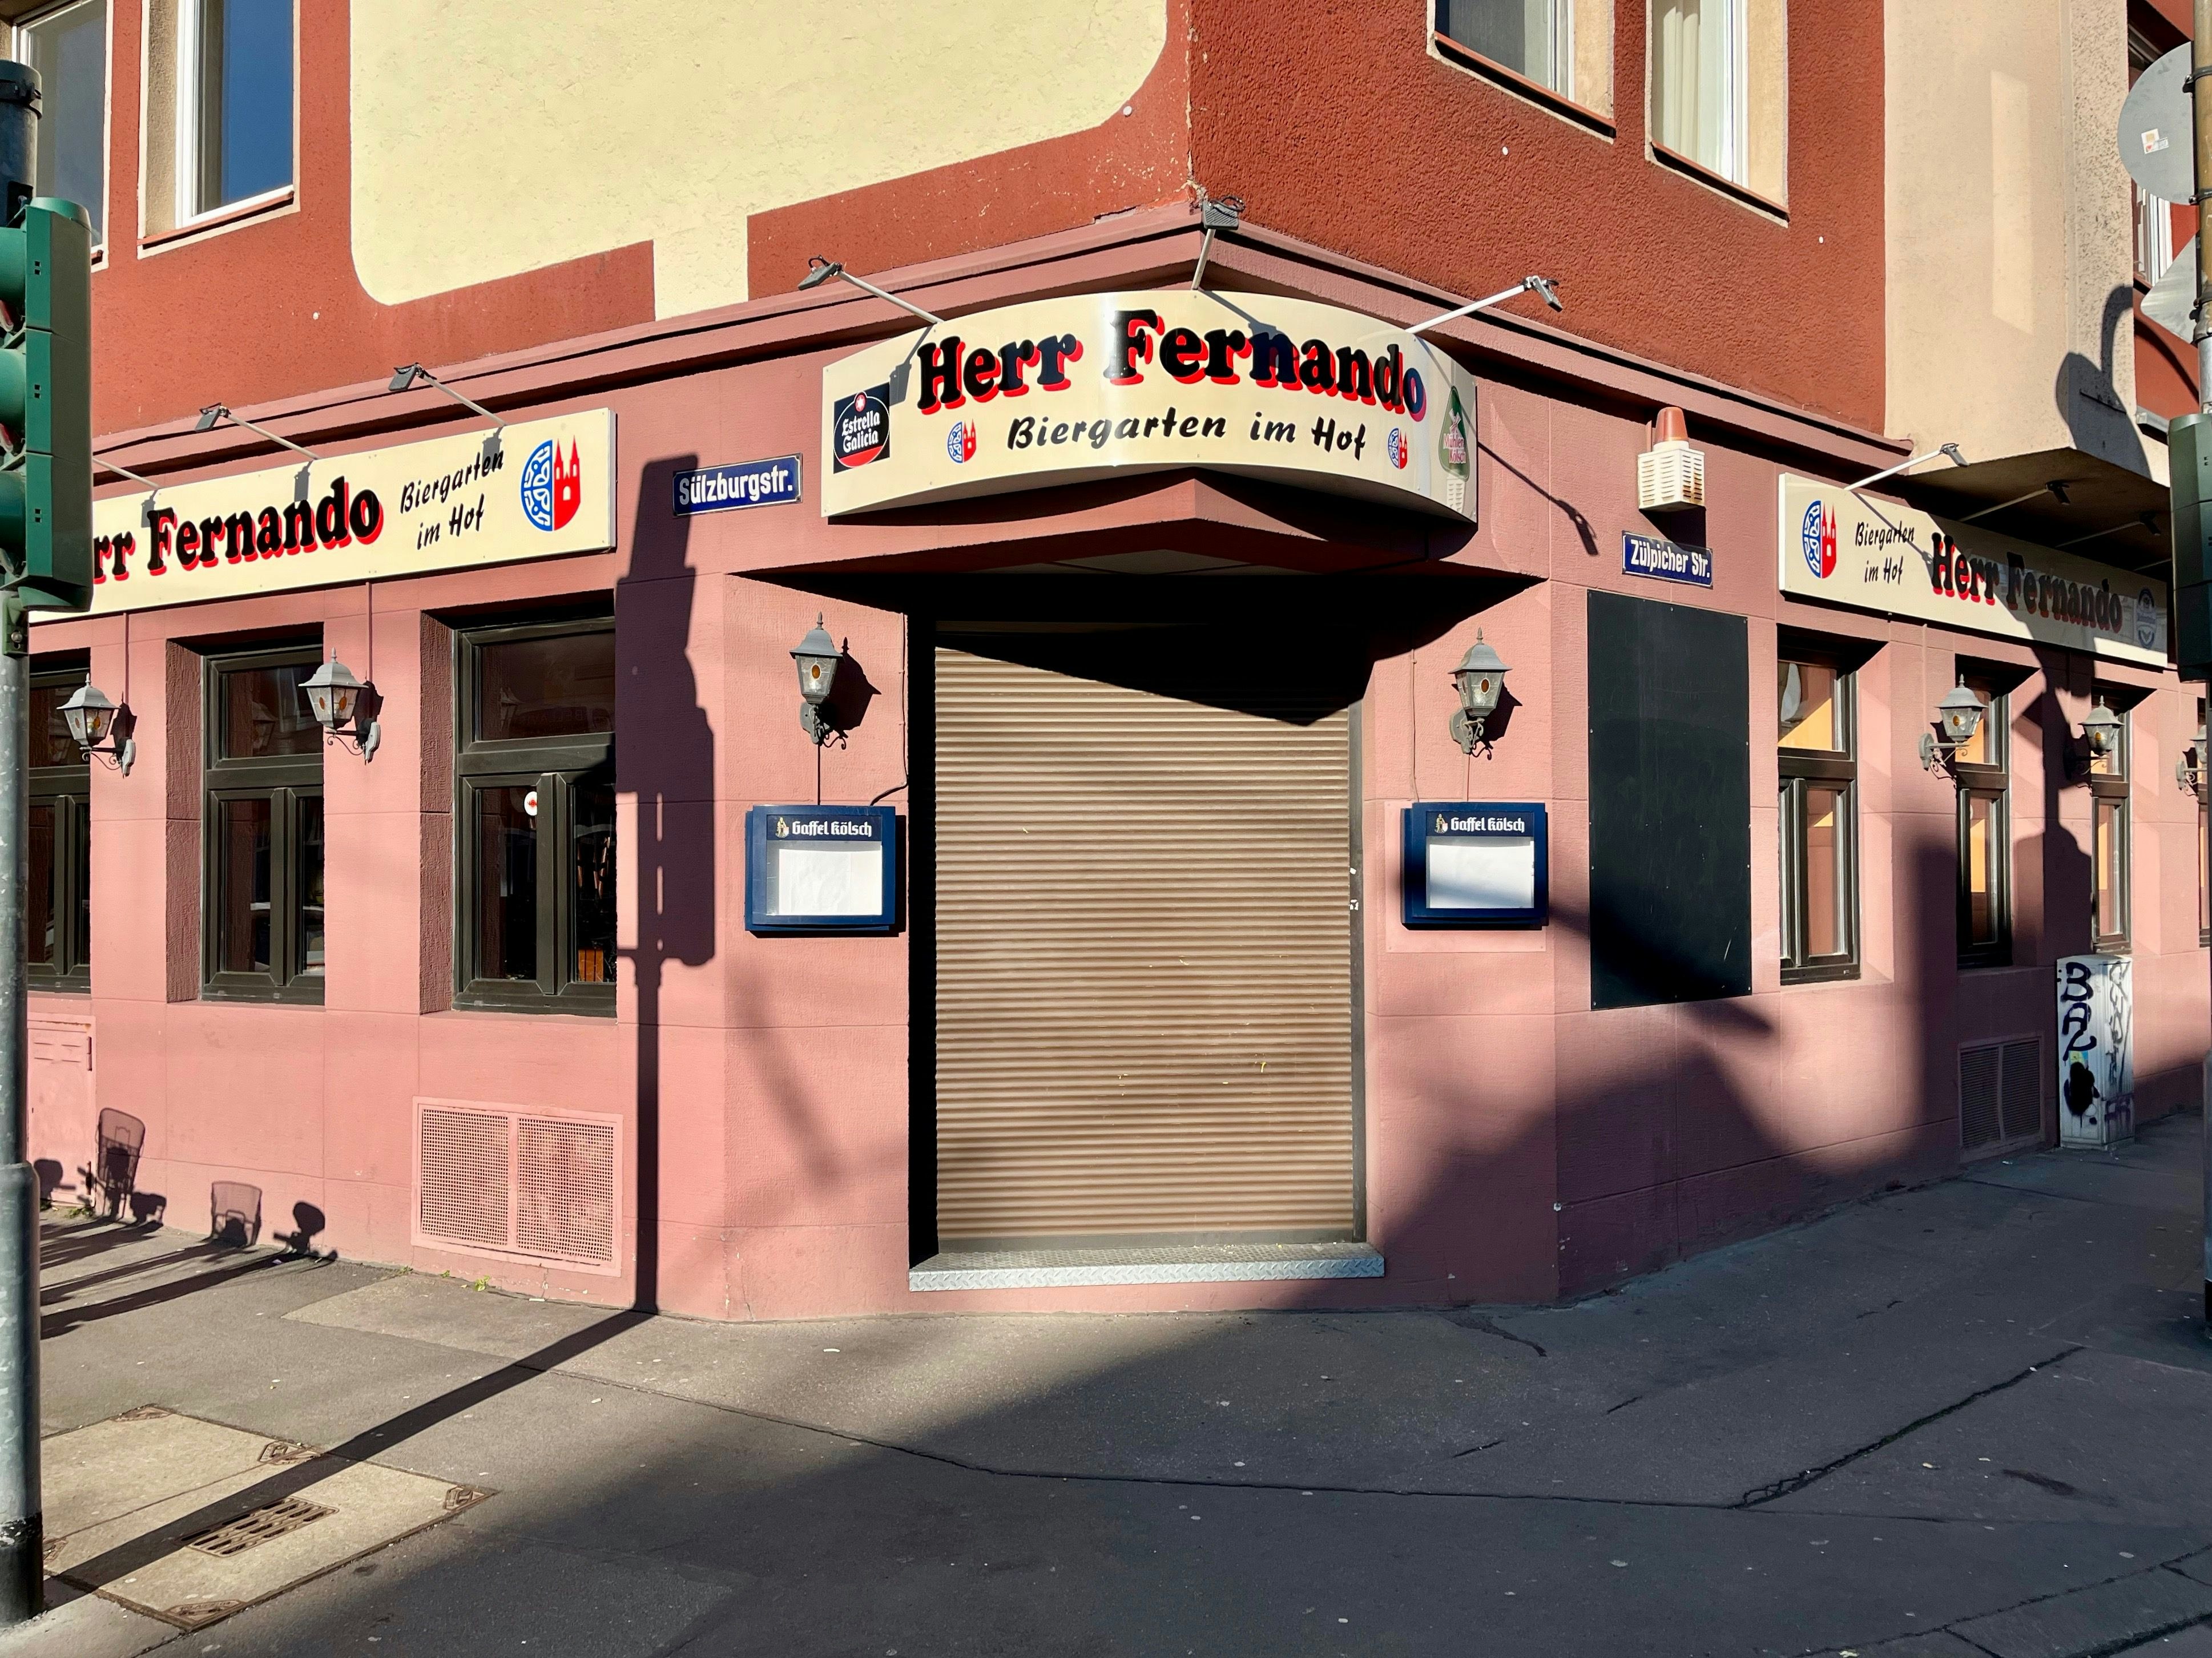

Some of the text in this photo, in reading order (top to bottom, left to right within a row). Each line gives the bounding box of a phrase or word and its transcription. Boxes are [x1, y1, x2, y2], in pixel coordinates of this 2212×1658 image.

[917, 309, 1427, 421] Herr Fernando
[842, 410, 880, 437] Estrella
[843, 428, 879, 453] Galicia
[1008, 406, 1367, 461] Biergarten im Hof
[400, 450, 503, 514] Biergarten
[679, 465, 793, 505] Sülzburgstr.
[93, 475, 384, 584] rr Fernando
[417, 493, 484, 550] im Hof
[1855, 520, 1915, 551] Biergarten
[1630, 539, 1710, 578] Zülpicher Str.
[1864, 555, 1903, 585] im Hof
[1931, 532, 2123, 634] Herr Fernando
[792, 820, 872, 838] Gaffel Kölsch
[1451, 817, 1525, 833] Gaffel Kölsch
